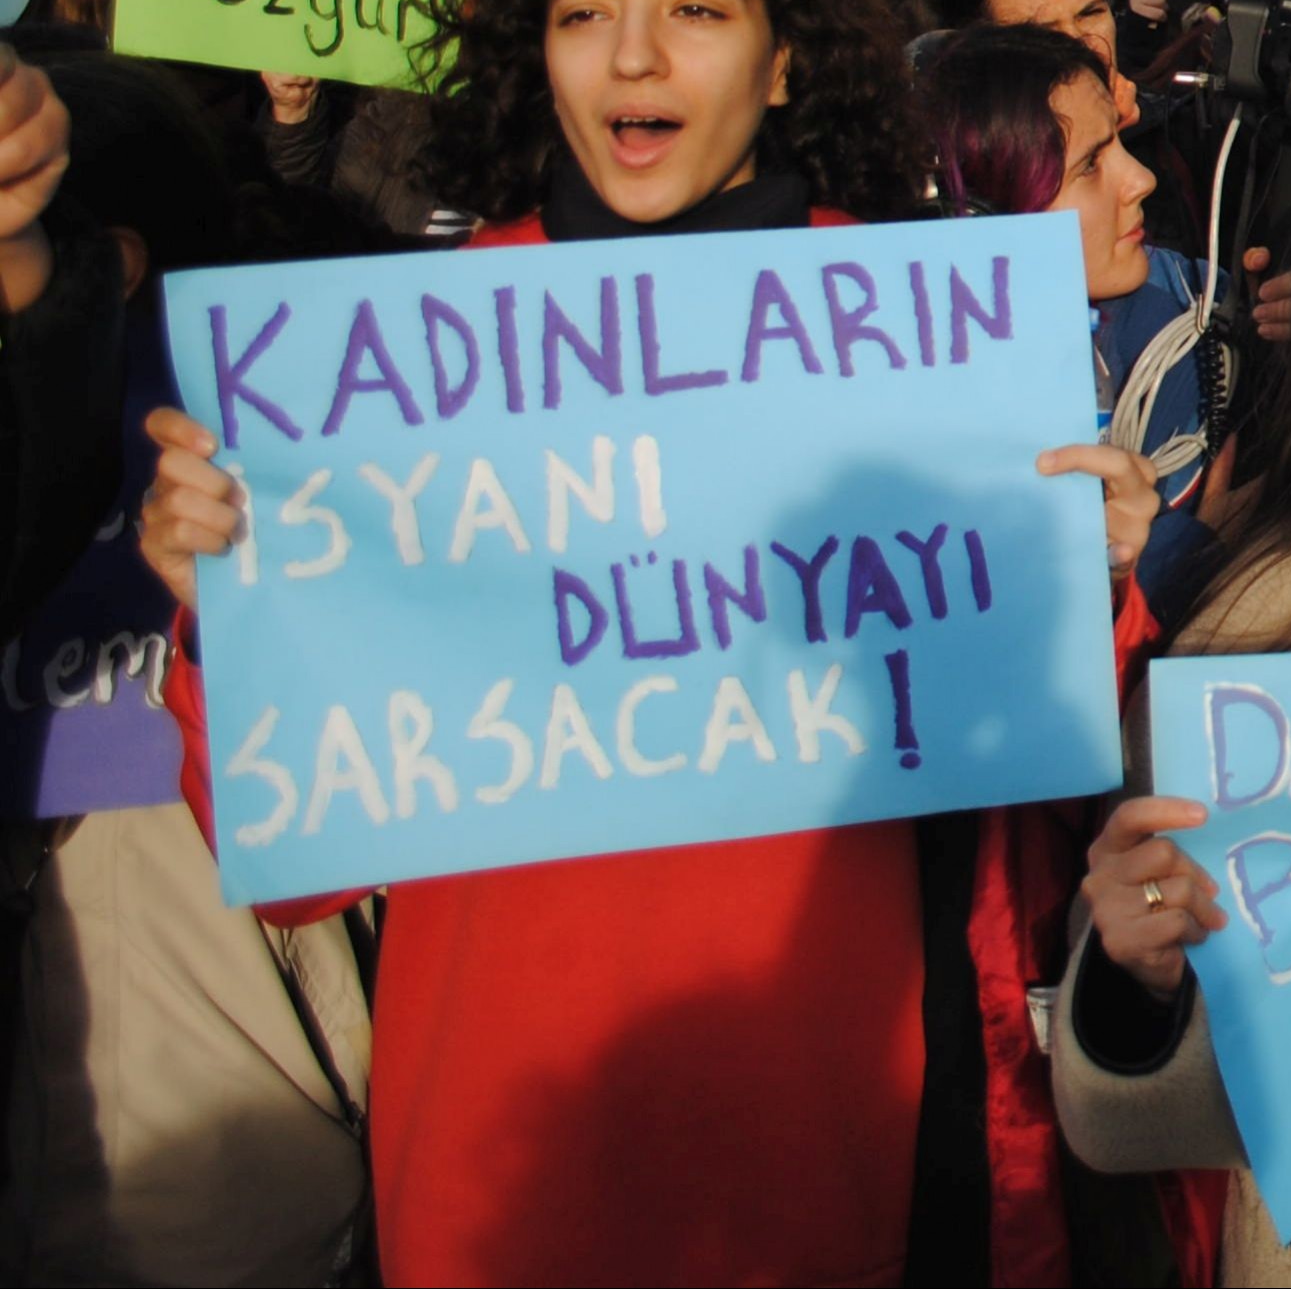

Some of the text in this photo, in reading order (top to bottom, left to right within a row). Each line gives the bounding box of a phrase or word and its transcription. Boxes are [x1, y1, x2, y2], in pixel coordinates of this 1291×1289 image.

[208, 256, 1015, 448] KADINLARIN
[236, 434, 668, 585] İSYANI
[551, 523, 992, 666] DÜNYAYI
